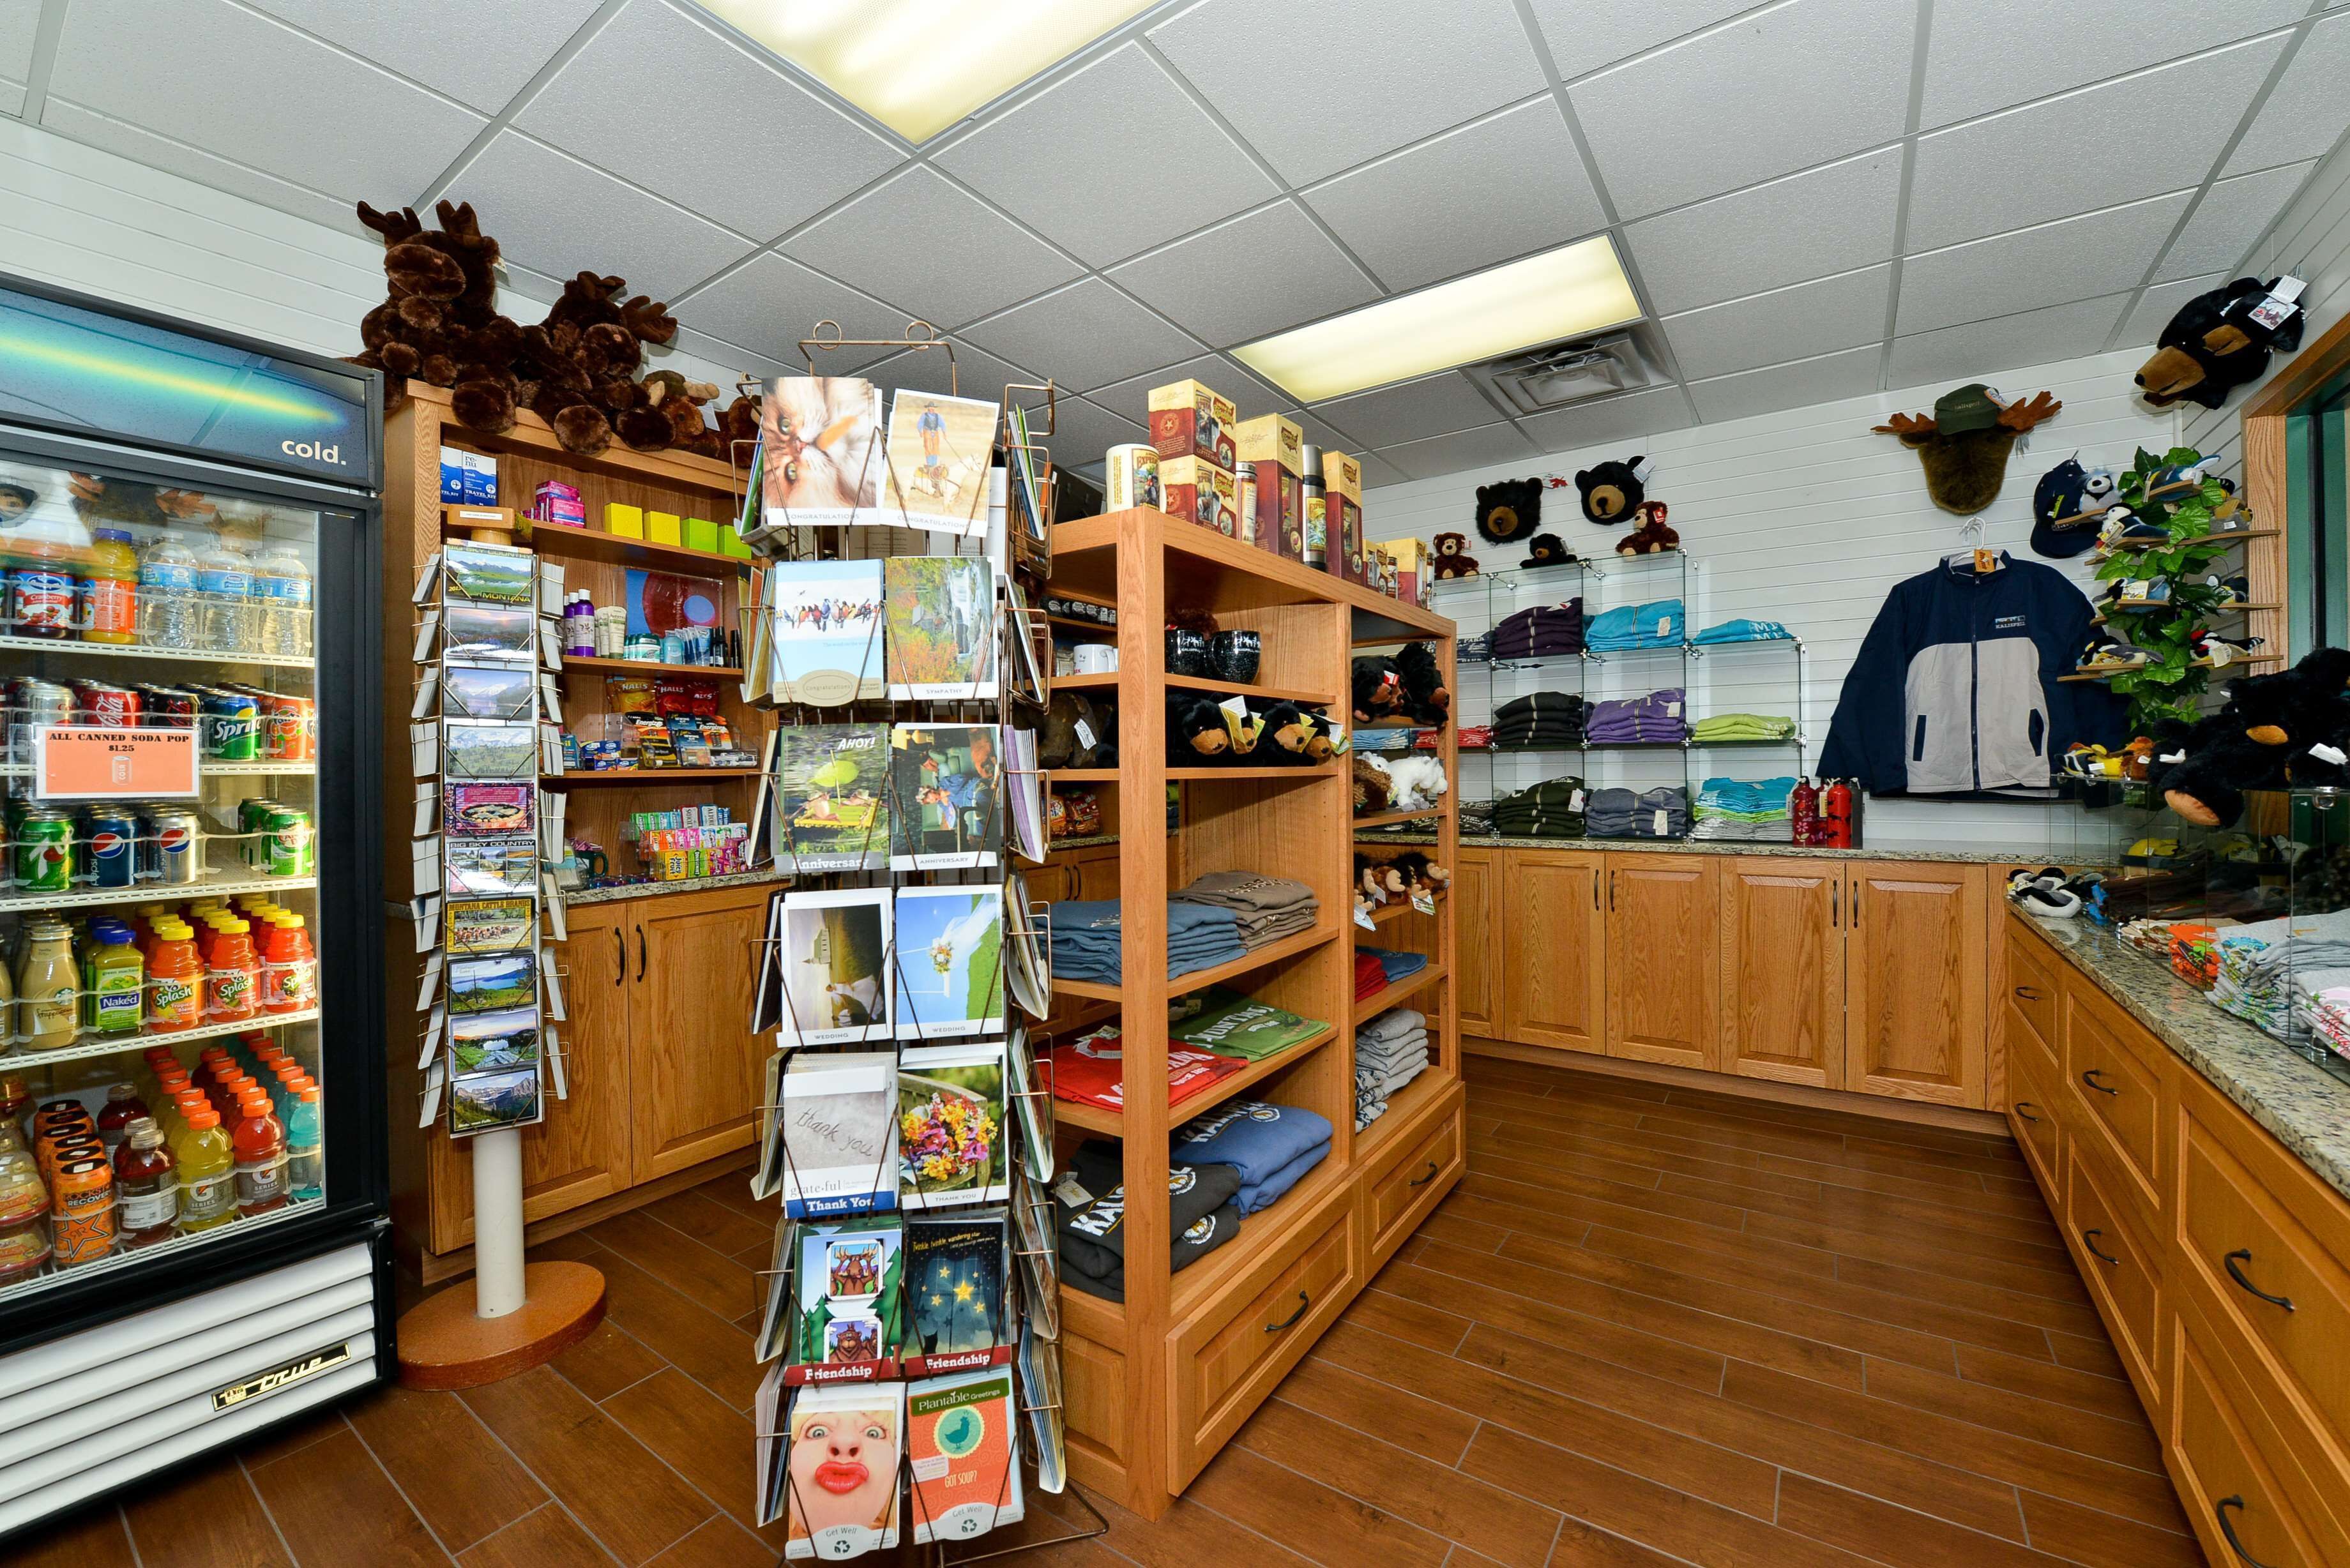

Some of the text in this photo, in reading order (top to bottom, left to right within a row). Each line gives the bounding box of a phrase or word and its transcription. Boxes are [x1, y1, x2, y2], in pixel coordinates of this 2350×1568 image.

[282, 440, 347, 465] cold.
[465, 488, 487, 497] TRAVEL
[488, 549, 533, 559] COUNTRY
[482, 591, 531, 603] MONTANA
[806, 684, 851, 693] Congratulations
[215, 717, 261, 741] Sprite
[78, 733, 126, 742] CANNED
[131, 734, 162, 743] SODA
[837, 736, 876, 752] AHOY!
[792, 857, 870, 872] Anniversary
[919, 856, 969, 865] ANNIVERSARY
[449, 900, 531, 911] MONTANA CATTLE BRANDS
[220, 976, 255, 997] Splash
[103, 995, 138, 1007] Naked
[156, 988, 193, 1007] Splash
[932, 1025, 966, 1034] WEDDING
[814, 1032, 849, 1041] WEDDING
[794, 1108, 874, 1157] thank you
[254, 1181, 278, 1191] SERIES
[192, 1199, 216, 1208] SERIES
[807, 1197, 849, 1212] Thank
[935, 1194, 961, 1203] THANK
[926, 1353, 991, 1370] Friendship
[259, 1357, 322, 1391] true
[805, 1365, 873, 1381] Friendship
[918, 1389, 1001, 1412] Plantable Greetings
[944, 1470, 978, 1488] GOT SOUP?
[952, 1505, 982, 1518] Get Well
[826, 1529, 838, 1537] Get
